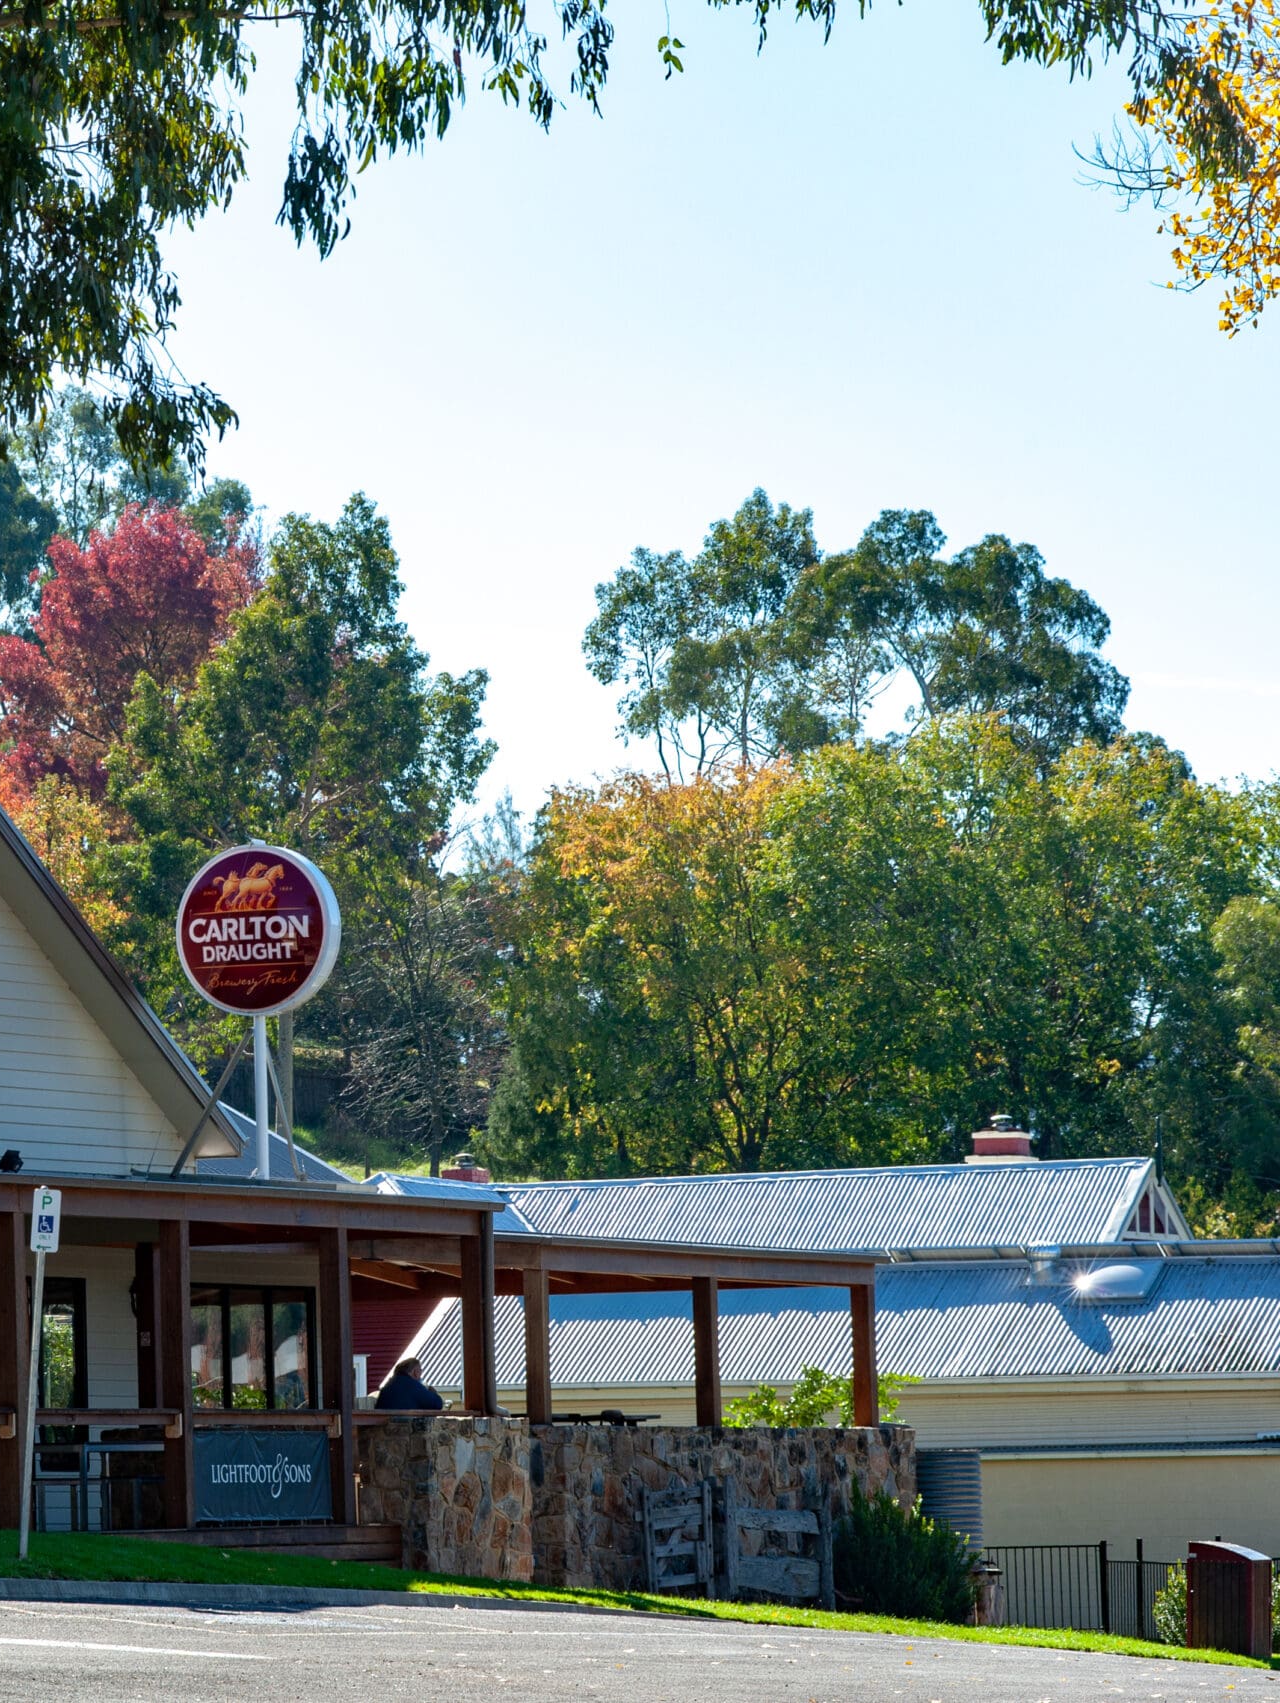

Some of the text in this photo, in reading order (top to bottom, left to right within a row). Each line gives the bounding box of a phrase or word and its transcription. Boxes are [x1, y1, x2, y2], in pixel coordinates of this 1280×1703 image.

[189, 915, 309, 943] CARLTON
[202, 942, 295, 963] DRAUGHT
[207, 969, 298, 996] Brewery Fresh
[42, 1195, 53, 1210] P
